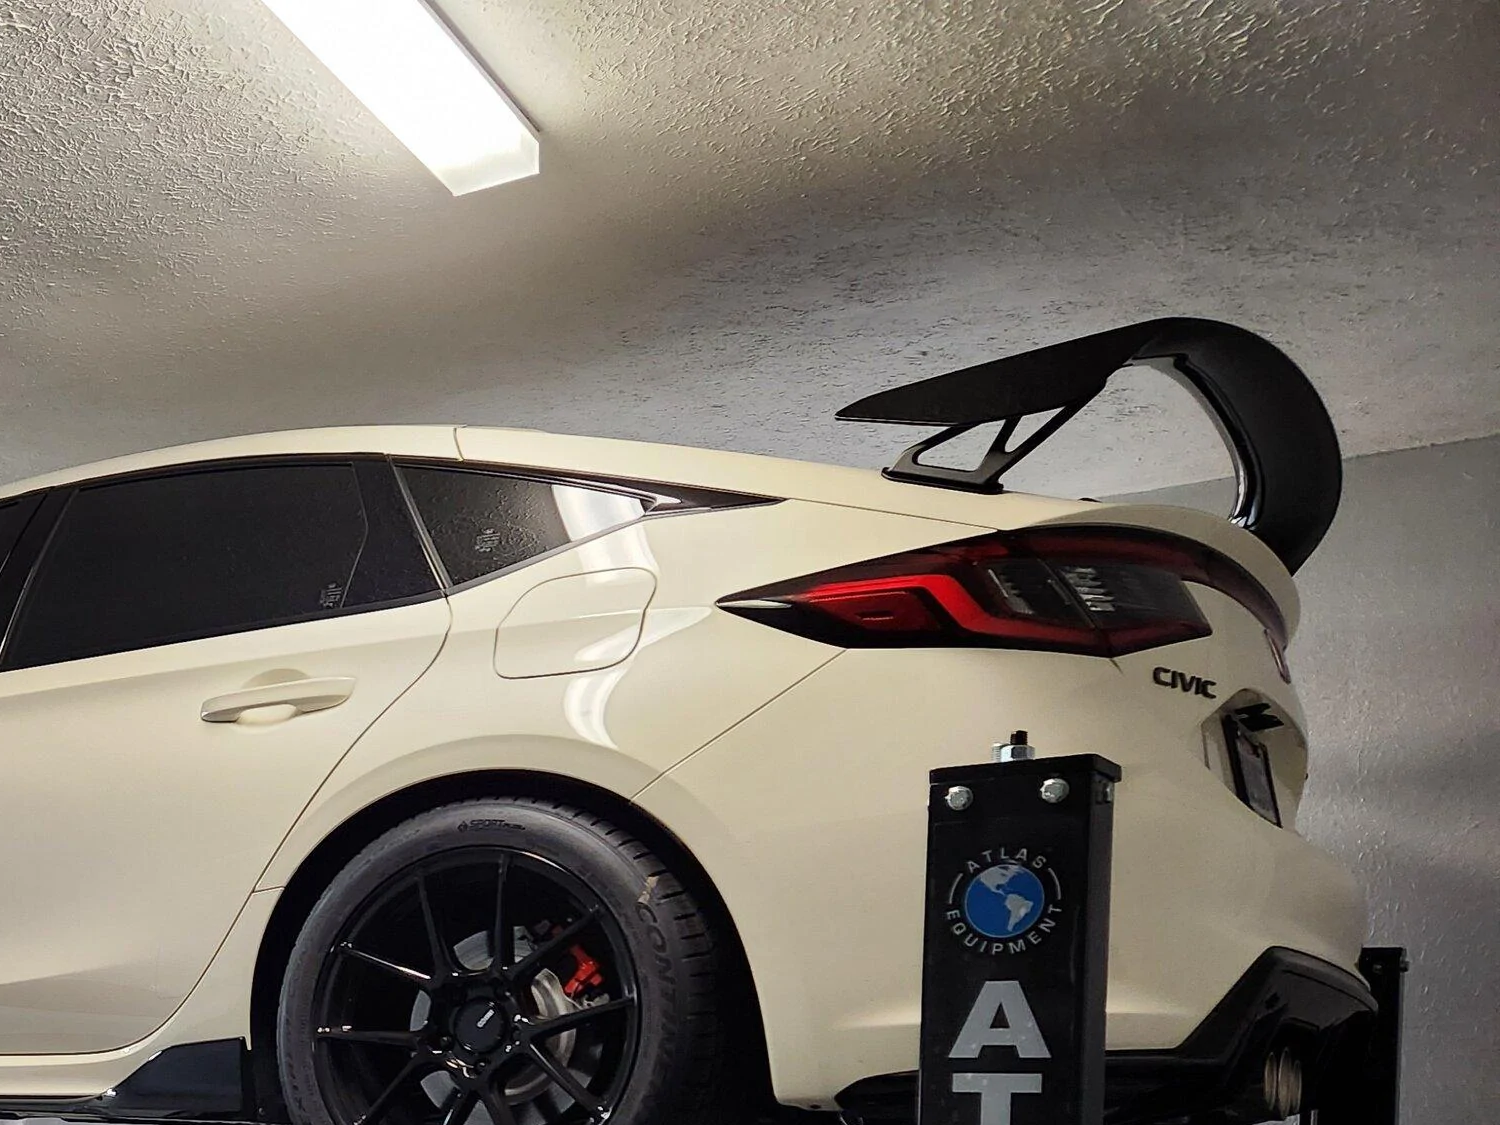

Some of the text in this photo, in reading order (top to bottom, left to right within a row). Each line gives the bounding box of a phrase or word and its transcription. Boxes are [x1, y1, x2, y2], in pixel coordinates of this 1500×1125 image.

[1153, 666, 1217, 699] CIVIC
[966, 847, 1047, 874] ATLAS
[946, 904, 1062, 956] EQUIPMENT
